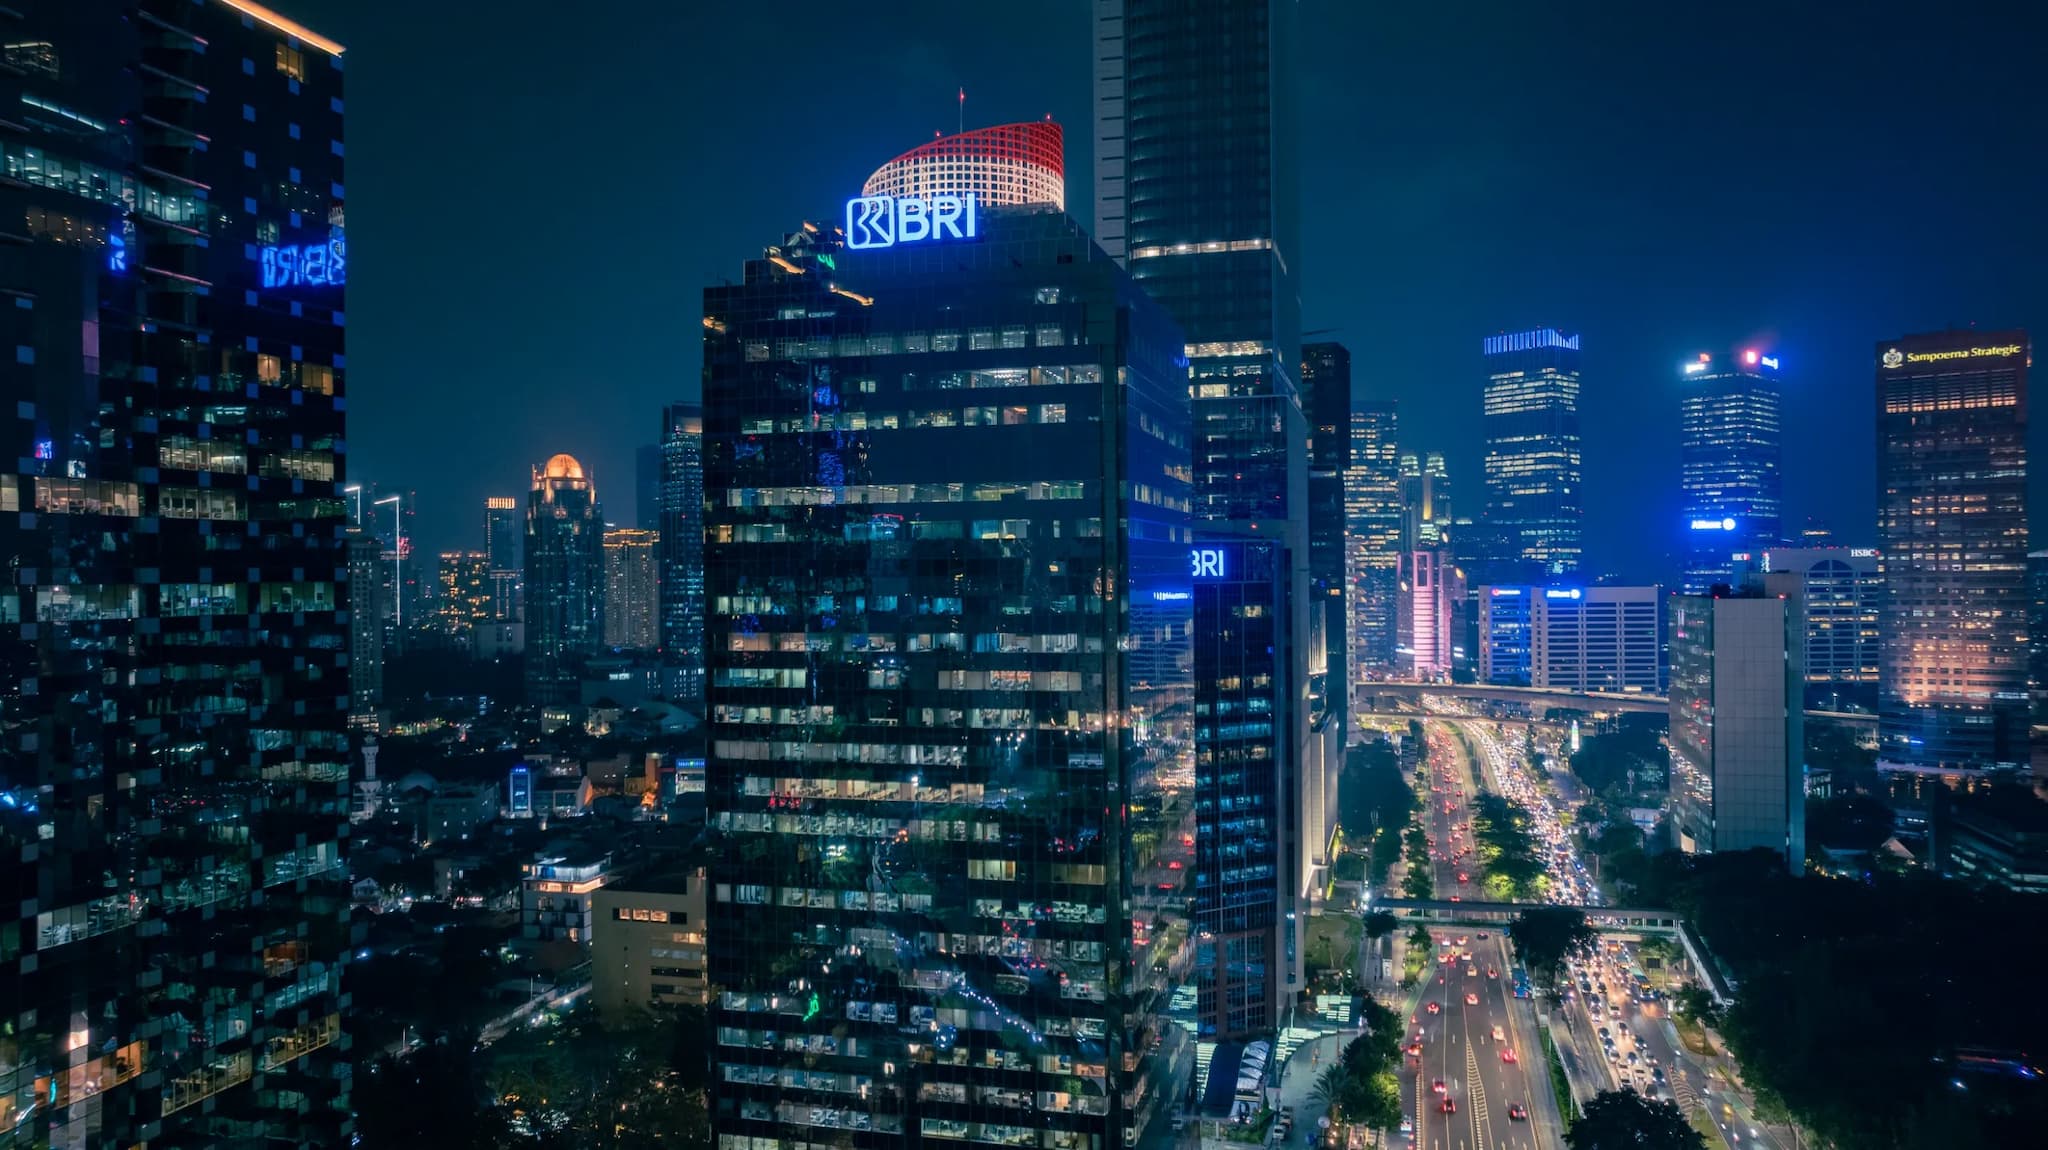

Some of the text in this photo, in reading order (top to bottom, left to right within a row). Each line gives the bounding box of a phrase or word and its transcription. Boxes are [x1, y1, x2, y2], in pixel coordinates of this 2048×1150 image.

[898, 193, 975, 241] BRI
[1907, 344, 2022, 362] Sampoerna Strategic
[1851, 548, 1875, 558] HSBC
